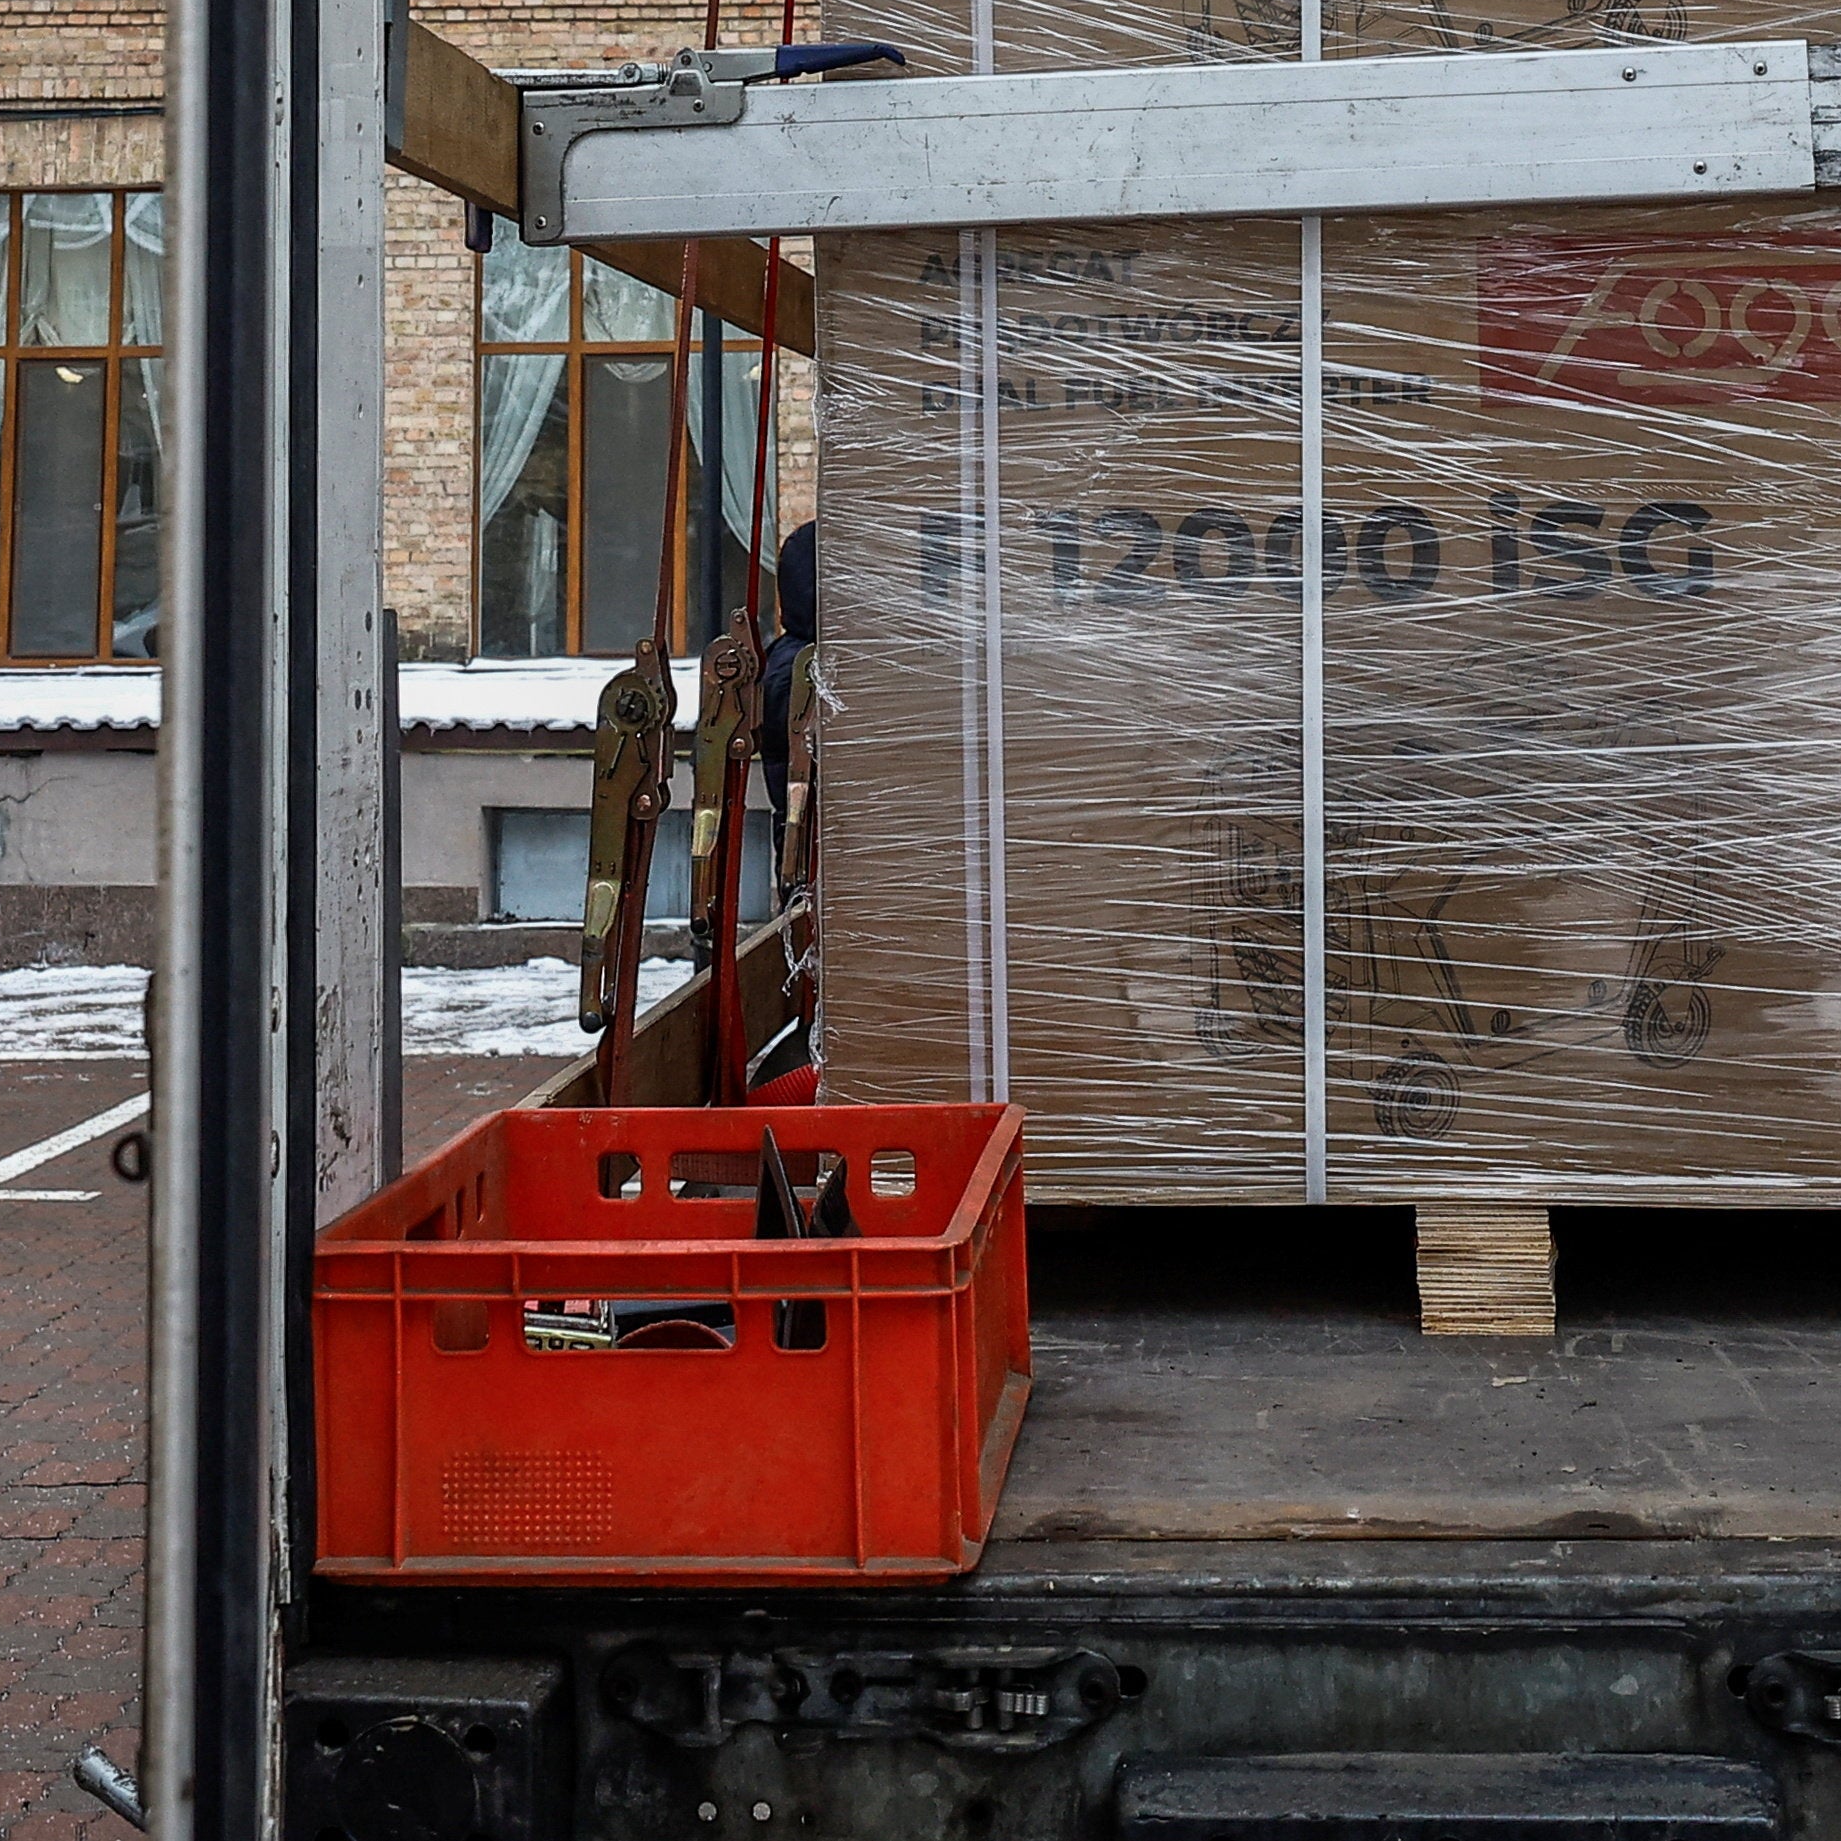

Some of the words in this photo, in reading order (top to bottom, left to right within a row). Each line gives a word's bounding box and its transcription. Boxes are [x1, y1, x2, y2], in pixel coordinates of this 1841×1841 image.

[1066, 374, 1170, 410] FUEL
[1028, 504, 1441, 608] 12000
[1487, 491, 1715, 603] iSG
